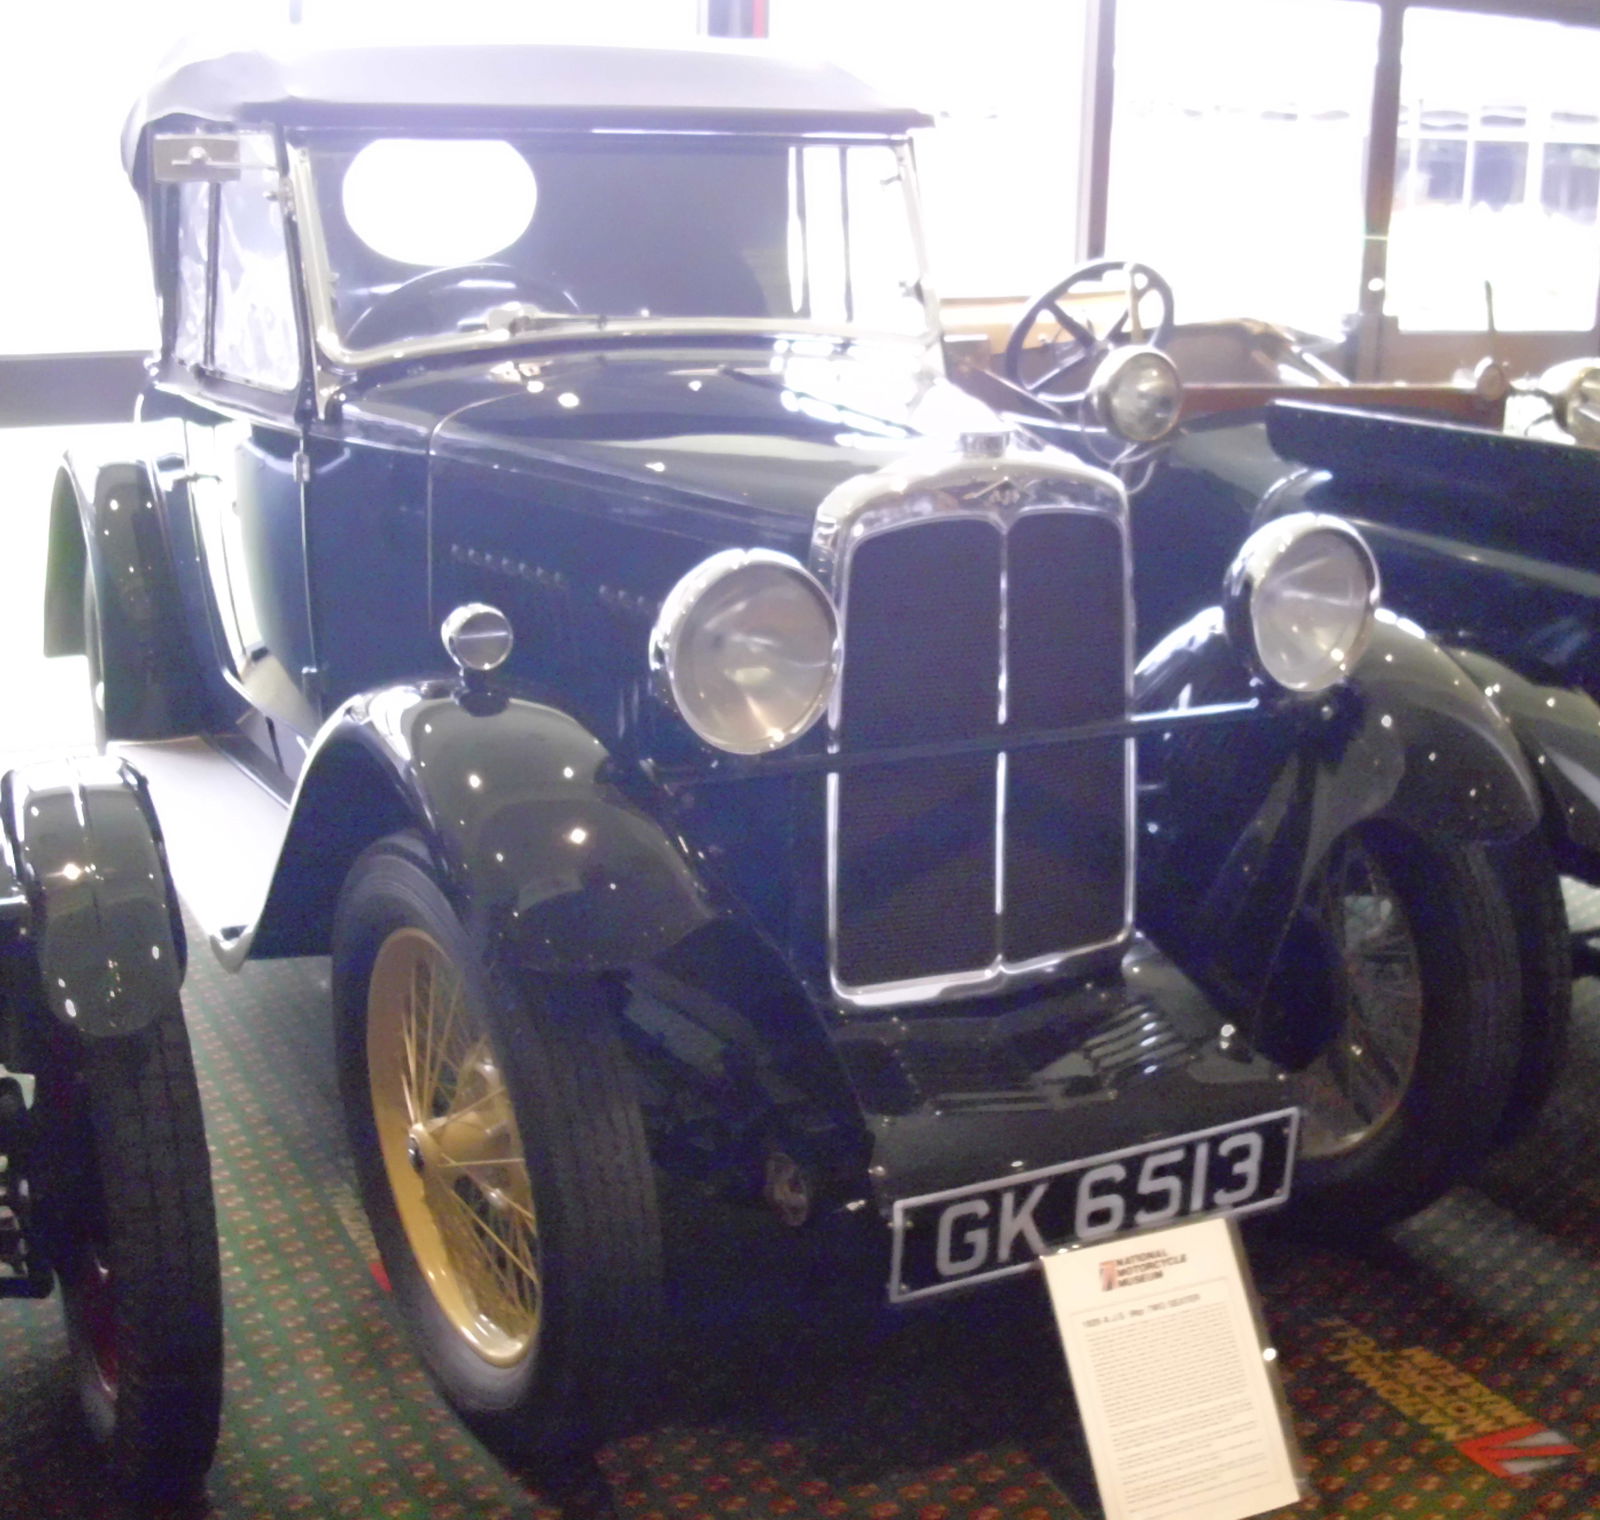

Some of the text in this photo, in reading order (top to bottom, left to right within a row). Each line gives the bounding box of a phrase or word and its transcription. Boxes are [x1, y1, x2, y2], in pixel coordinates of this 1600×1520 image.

[936, 1131, 1263, 1276] GK 6513
[1114, 1248, 1168, 1266] NATIONAL
[1115, 1253, 1187, 1276] MOTORCYCLE
[1115, 1269, 1163, 1287] MUSEUM
